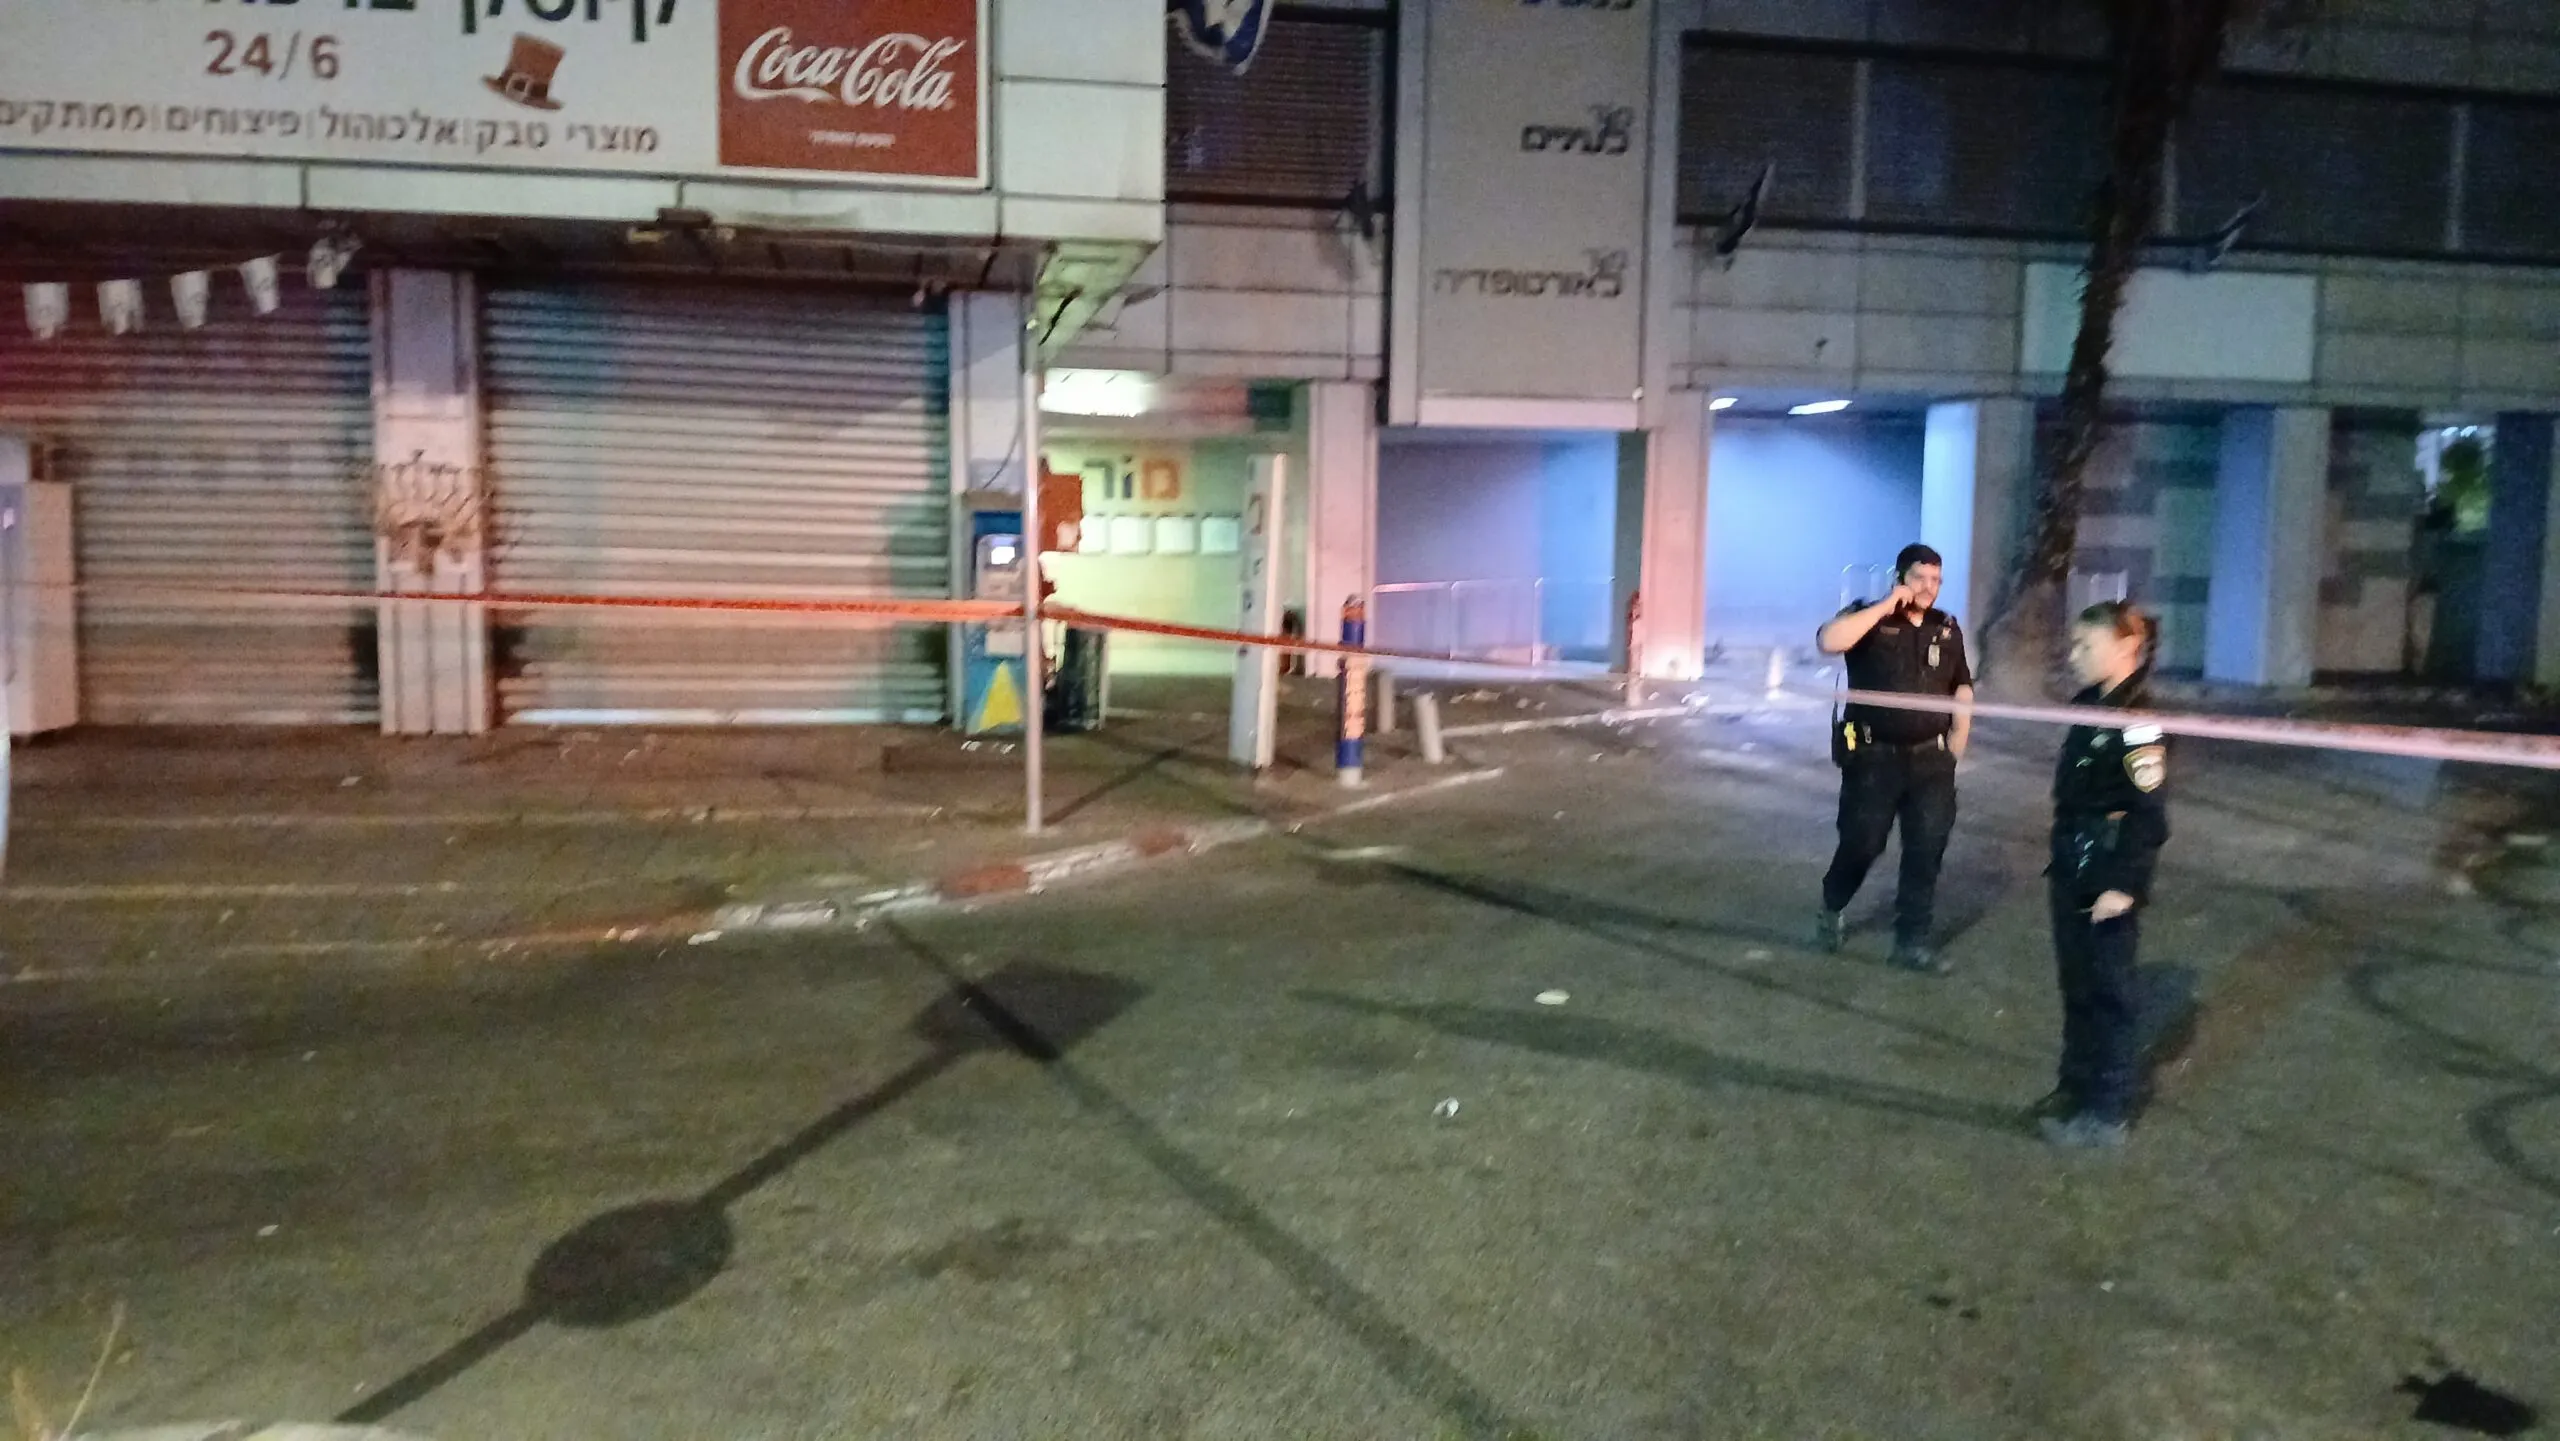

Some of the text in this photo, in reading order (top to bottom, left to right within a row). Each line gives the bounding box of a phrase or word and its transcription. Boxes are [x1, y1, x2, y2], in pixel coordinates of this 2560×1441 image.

[204, 28, 340, 80] 24/6
[166, 104, 301, 137] פיצוחים
[319, 102, 457, 146] אלכוהול
[475, 117, 551, 154] טבק
[565, 121, 660, 153] מוצרי
